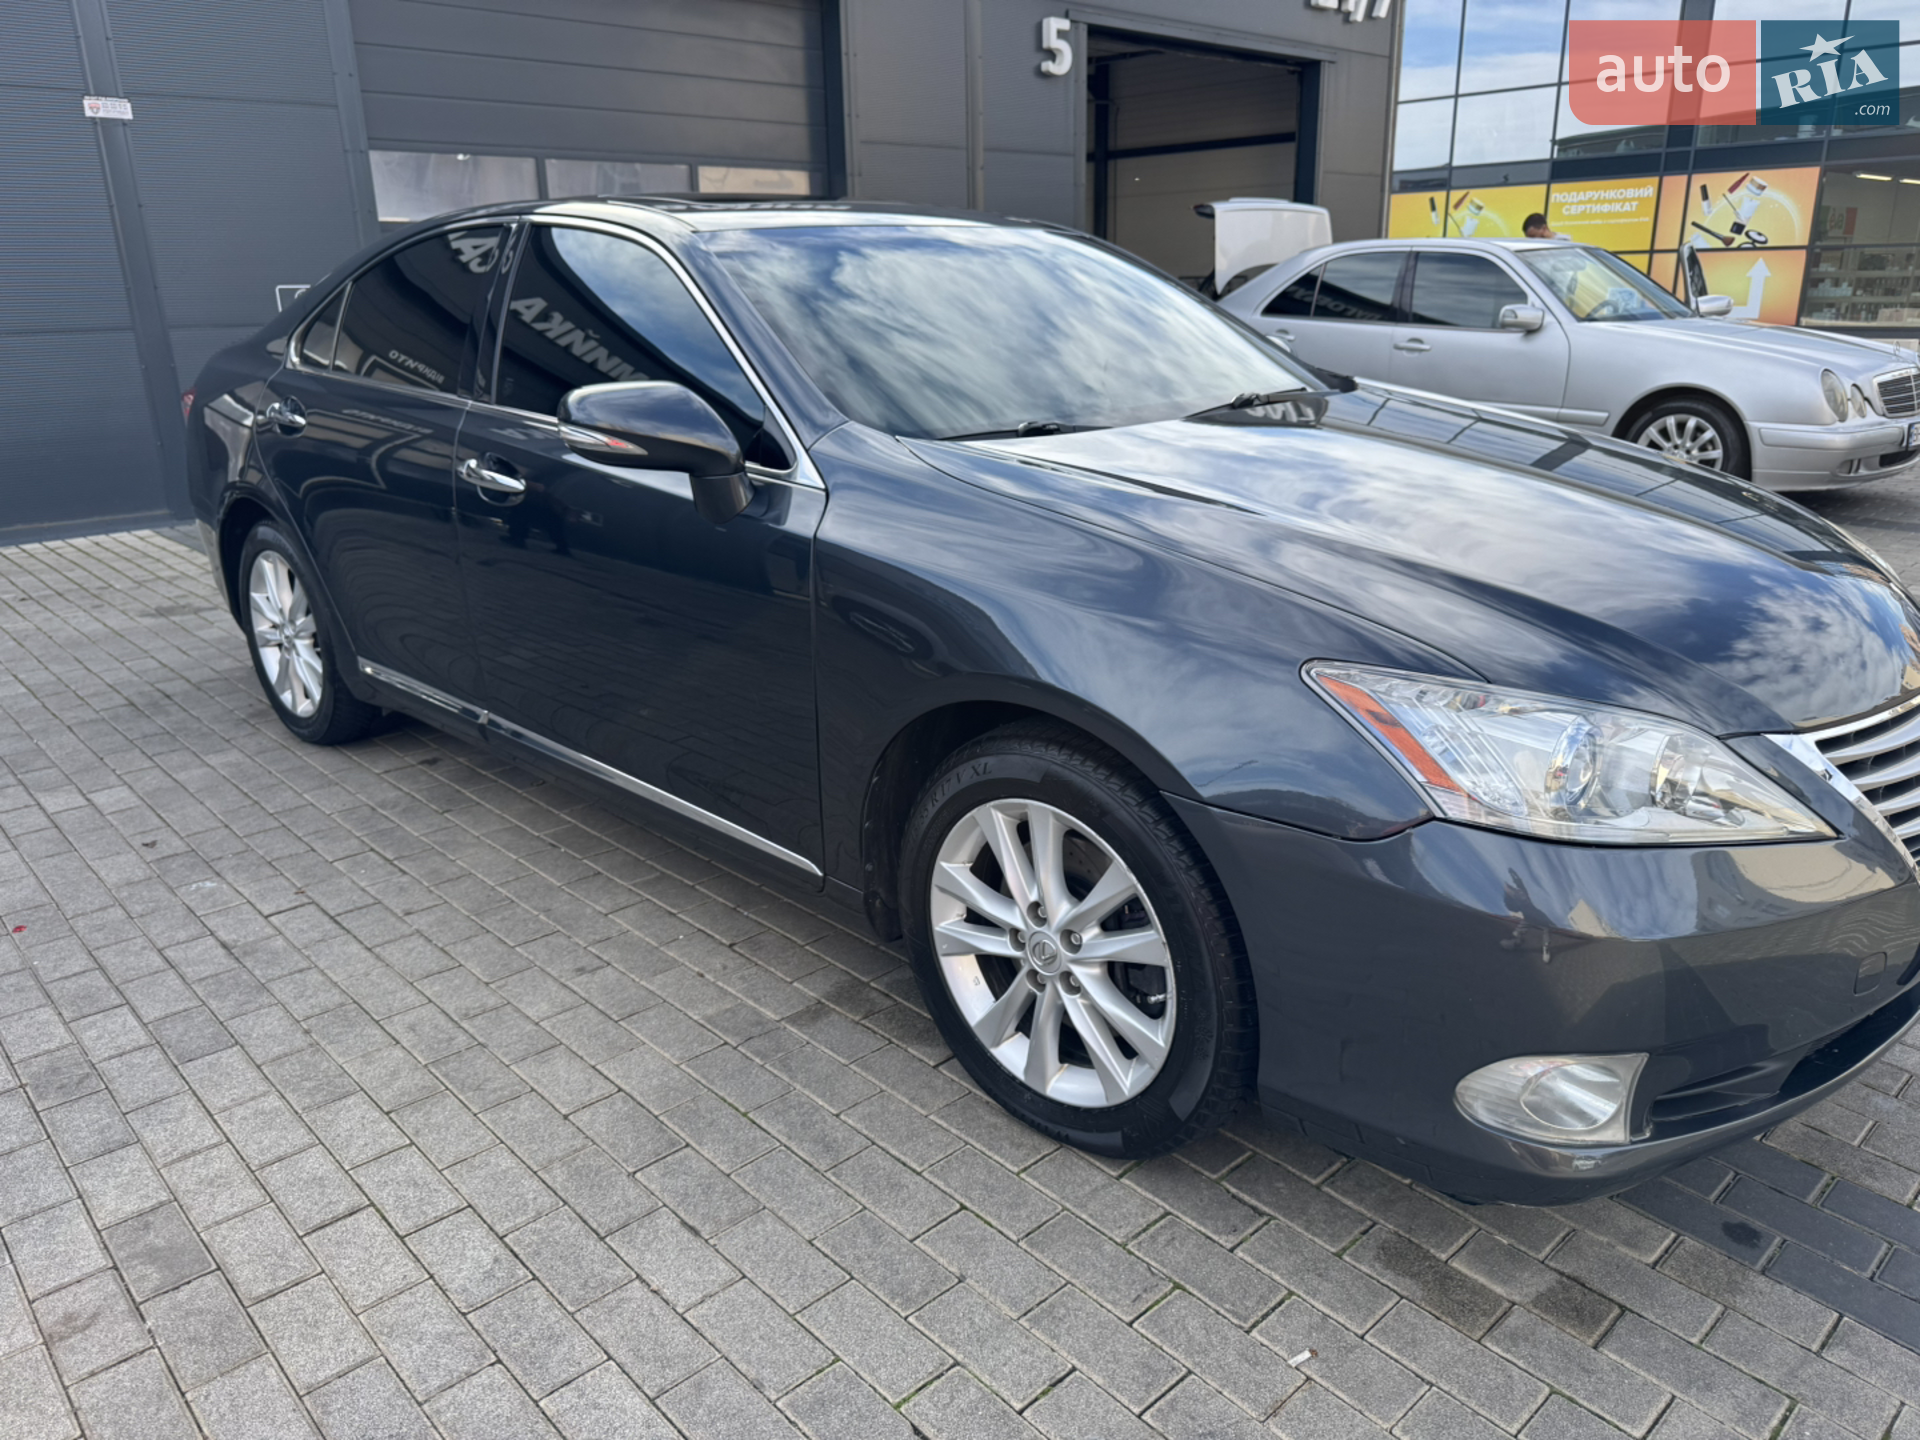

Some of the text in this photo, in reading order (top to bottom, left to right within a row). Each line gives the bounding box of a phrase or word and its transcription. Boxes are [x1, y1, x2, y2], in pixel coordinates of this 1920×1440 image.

[1041, 16, 1073, 76] 5
[1551, 185, 1654, 203] ПОДАРУНКОВИЙ
[1562, 201, 1639, 215] СЕРТИФІКАТ
[970, 762, 993, 779] XL
